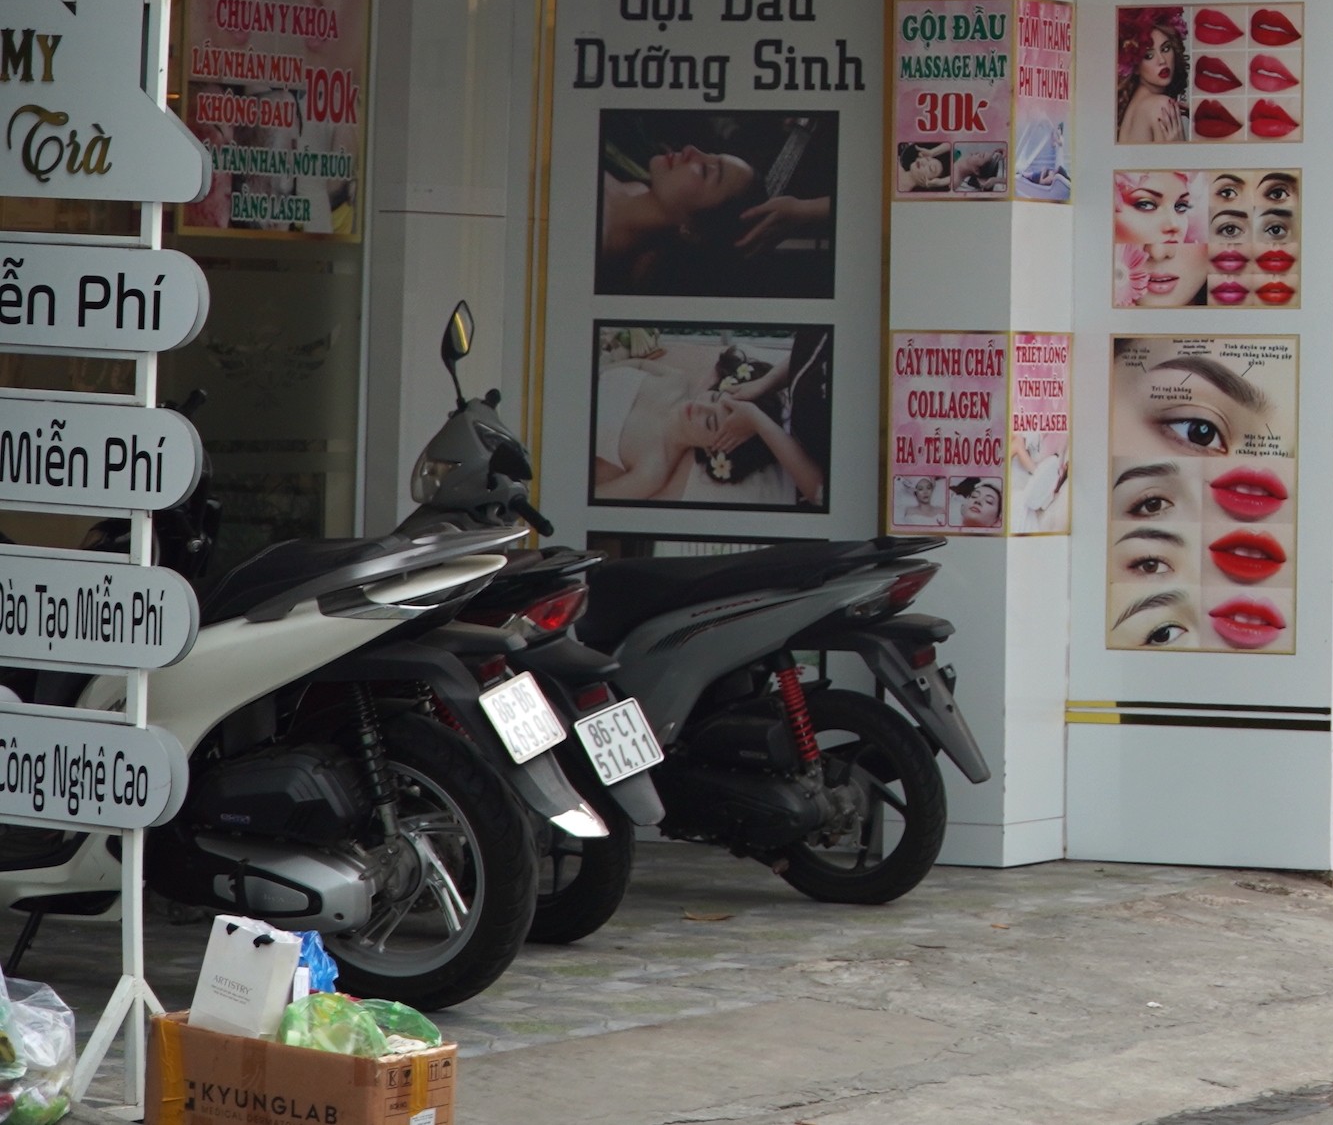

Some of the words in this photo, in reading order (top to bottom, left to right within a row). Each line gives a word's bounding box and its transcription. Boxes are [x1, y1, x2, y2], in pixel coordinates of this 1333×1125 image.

[292, 7, 339, 40] KHOA
[902, 8, 947, 48] GỘI
[952, 5, 1007, 42] ĐẦU
[191, 42, 227, 77] LẤY
[227, 47, 267, 84] NHÂN
[269, 56, 304, 90] MỤN
[573, 38, 730, 103] Dưỡng
[753, 39, 865, 91] Sinh
[900, 55, 972, 79] MASSAGE
[974, 50, 1008, 86] MẶT
[196, 87, 258, 127] KHÔNG
[260, 98, 296, 129] ĐAU
[917, 92, 989, 132] 30k
[270, 196, 312, 223] LASER
[78, 273, 166, 331] Phí
[896, 339, 926, 376] CẤY
[926, 348, 963, 377] TINH
[964, 339, 1005, 377] CHẤT
[907, 390, 991, 420] COLLAGEN
[1039, 414, 1067, 432] LASER
[103, 436, 167, 493] Phí
[896, 436, 916, 464] HA
[35, 584, 69, 651] Tạo
[73, 575, 125, 643] Miễn
[131, 589, 165, 647] Phí
[588, 708, 638, 749] 86-C1
[595, 733, 657, 780] 514.11
[52, 743, 106, 815] Nghệ
[111, 749, 149, 807] Cao
[201, 1080, 339, 1125] KYUNGLAB
